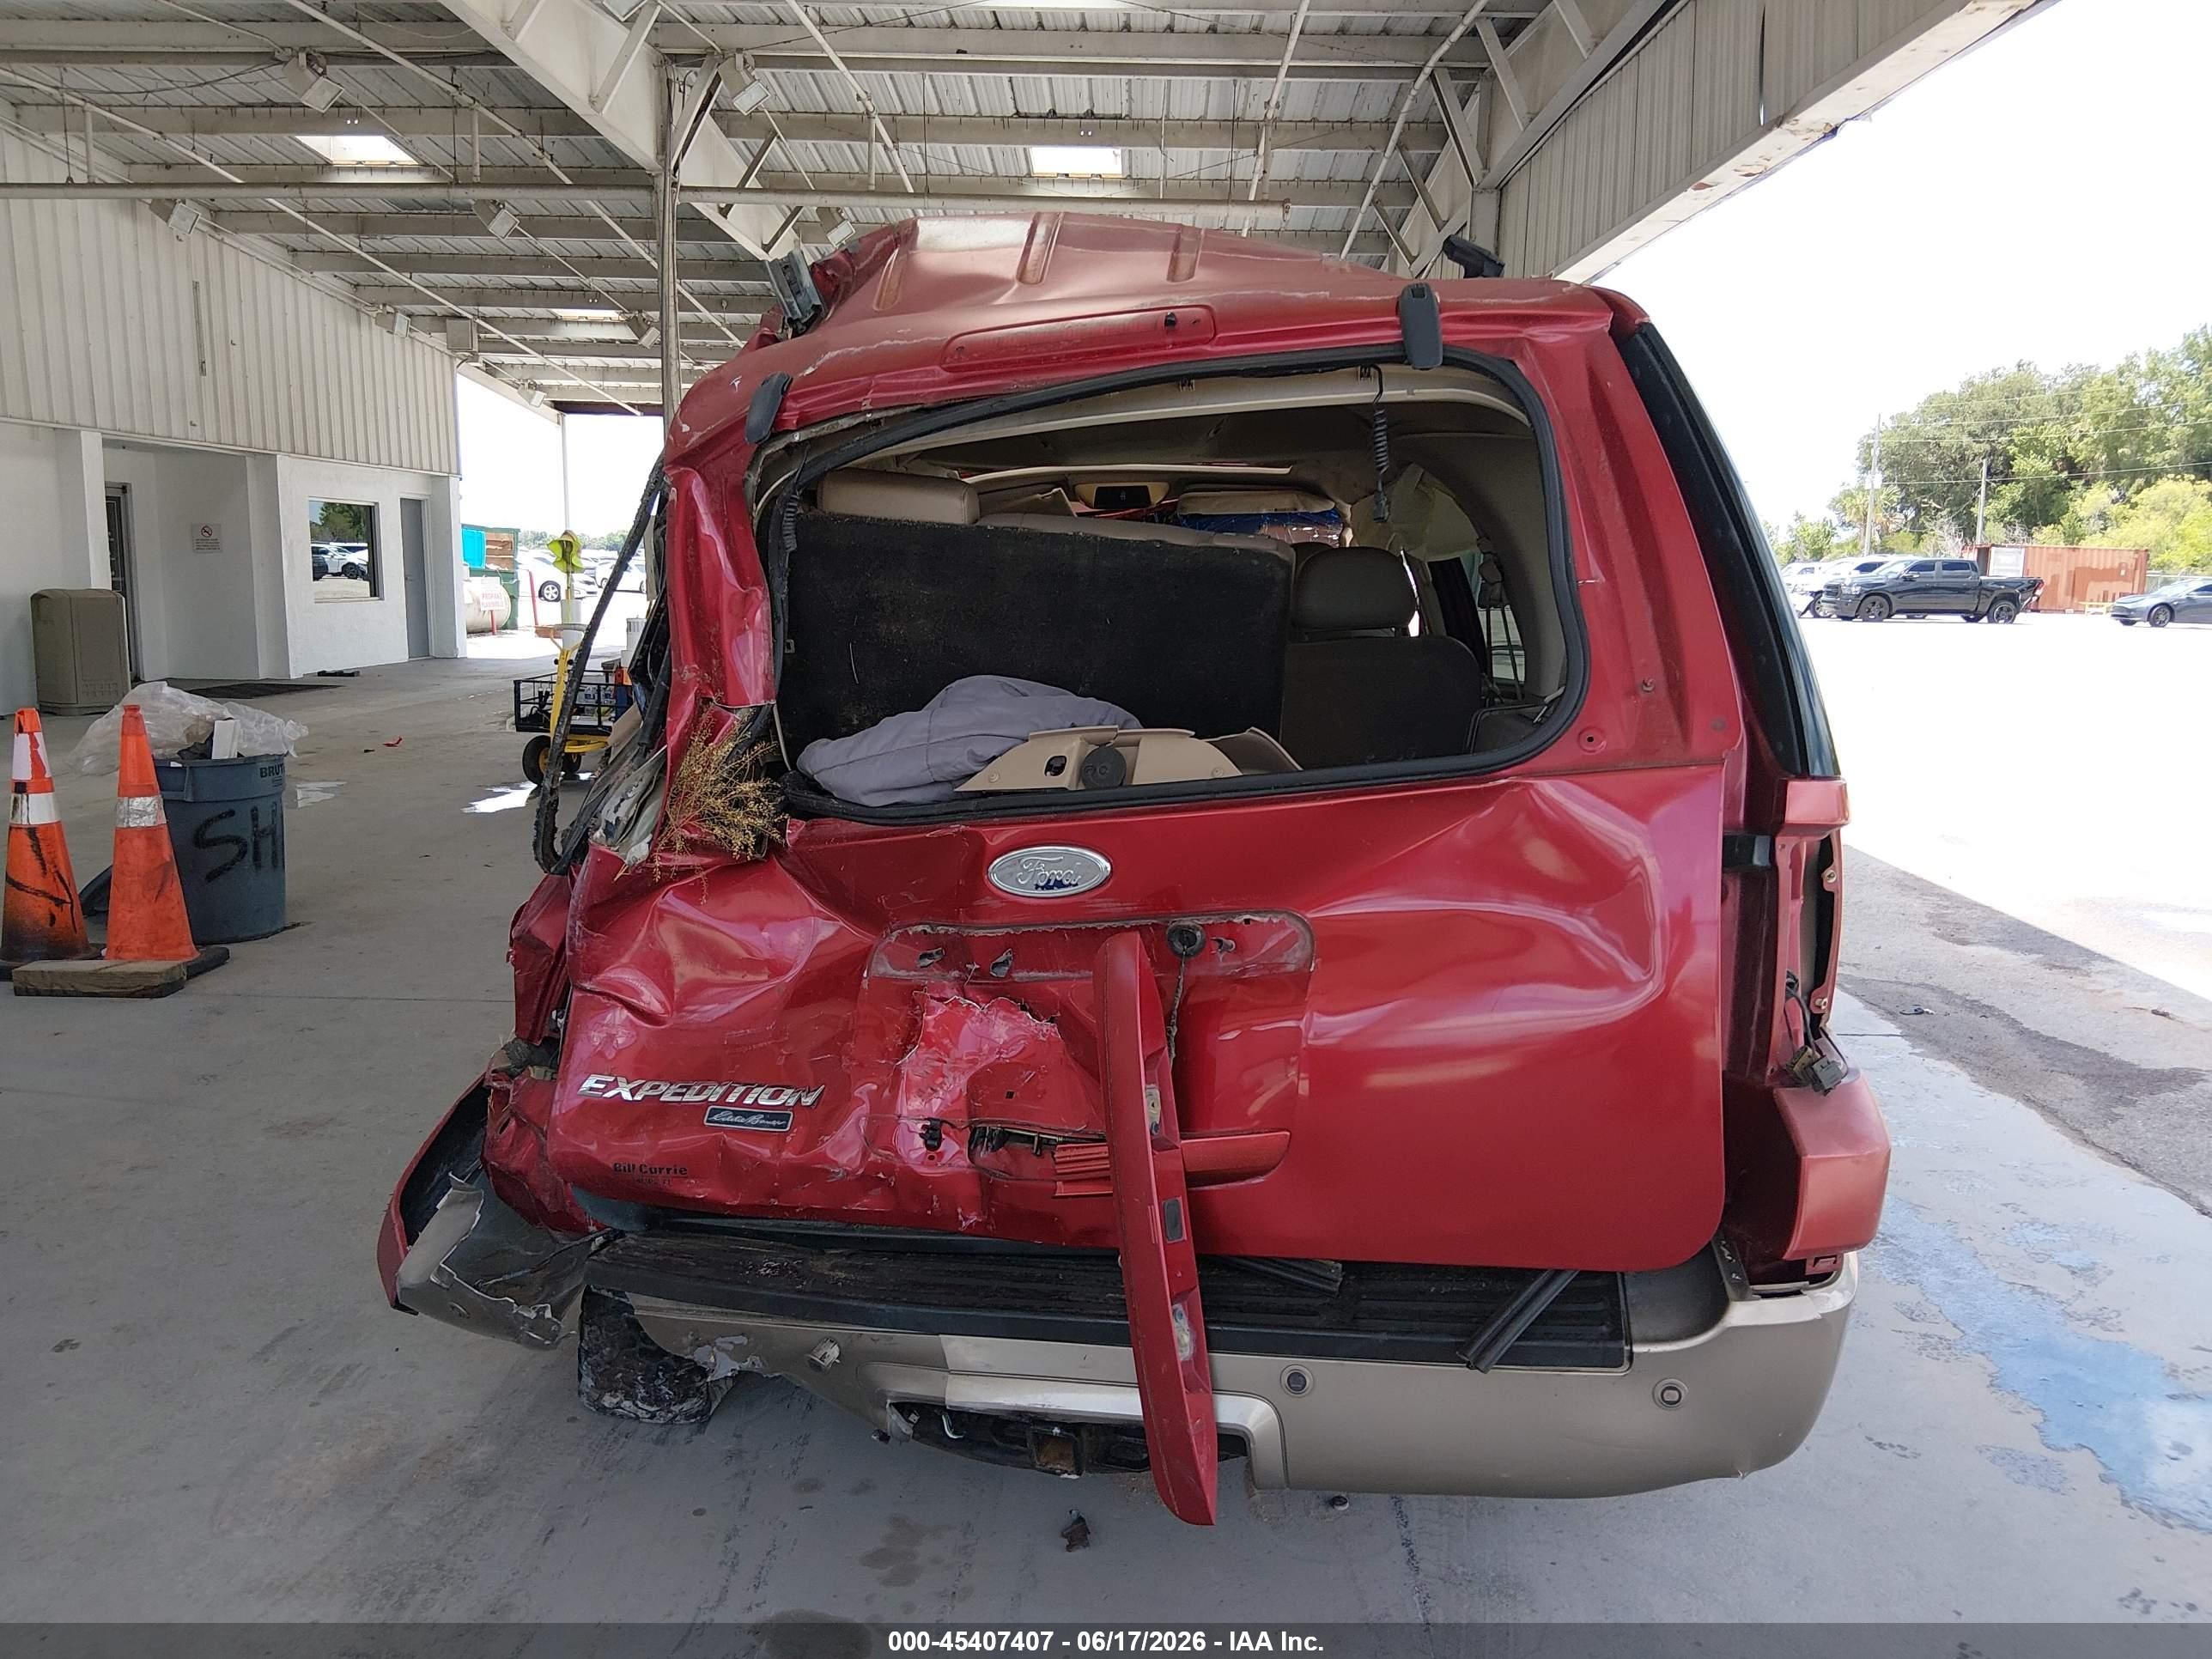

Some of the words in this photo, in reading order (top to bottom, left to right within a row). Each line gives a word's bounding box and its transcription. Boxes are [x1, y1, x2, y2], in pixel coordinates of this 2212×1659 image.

[259, 763, 285, 778] BRUT
[1017, 856, 1082, 886] Ford
[577, 1073, 824, 1109] EXPEDITION
[613, 1162, 635, 1173] Bill
[639, 1163, 688, 1176] Currie
